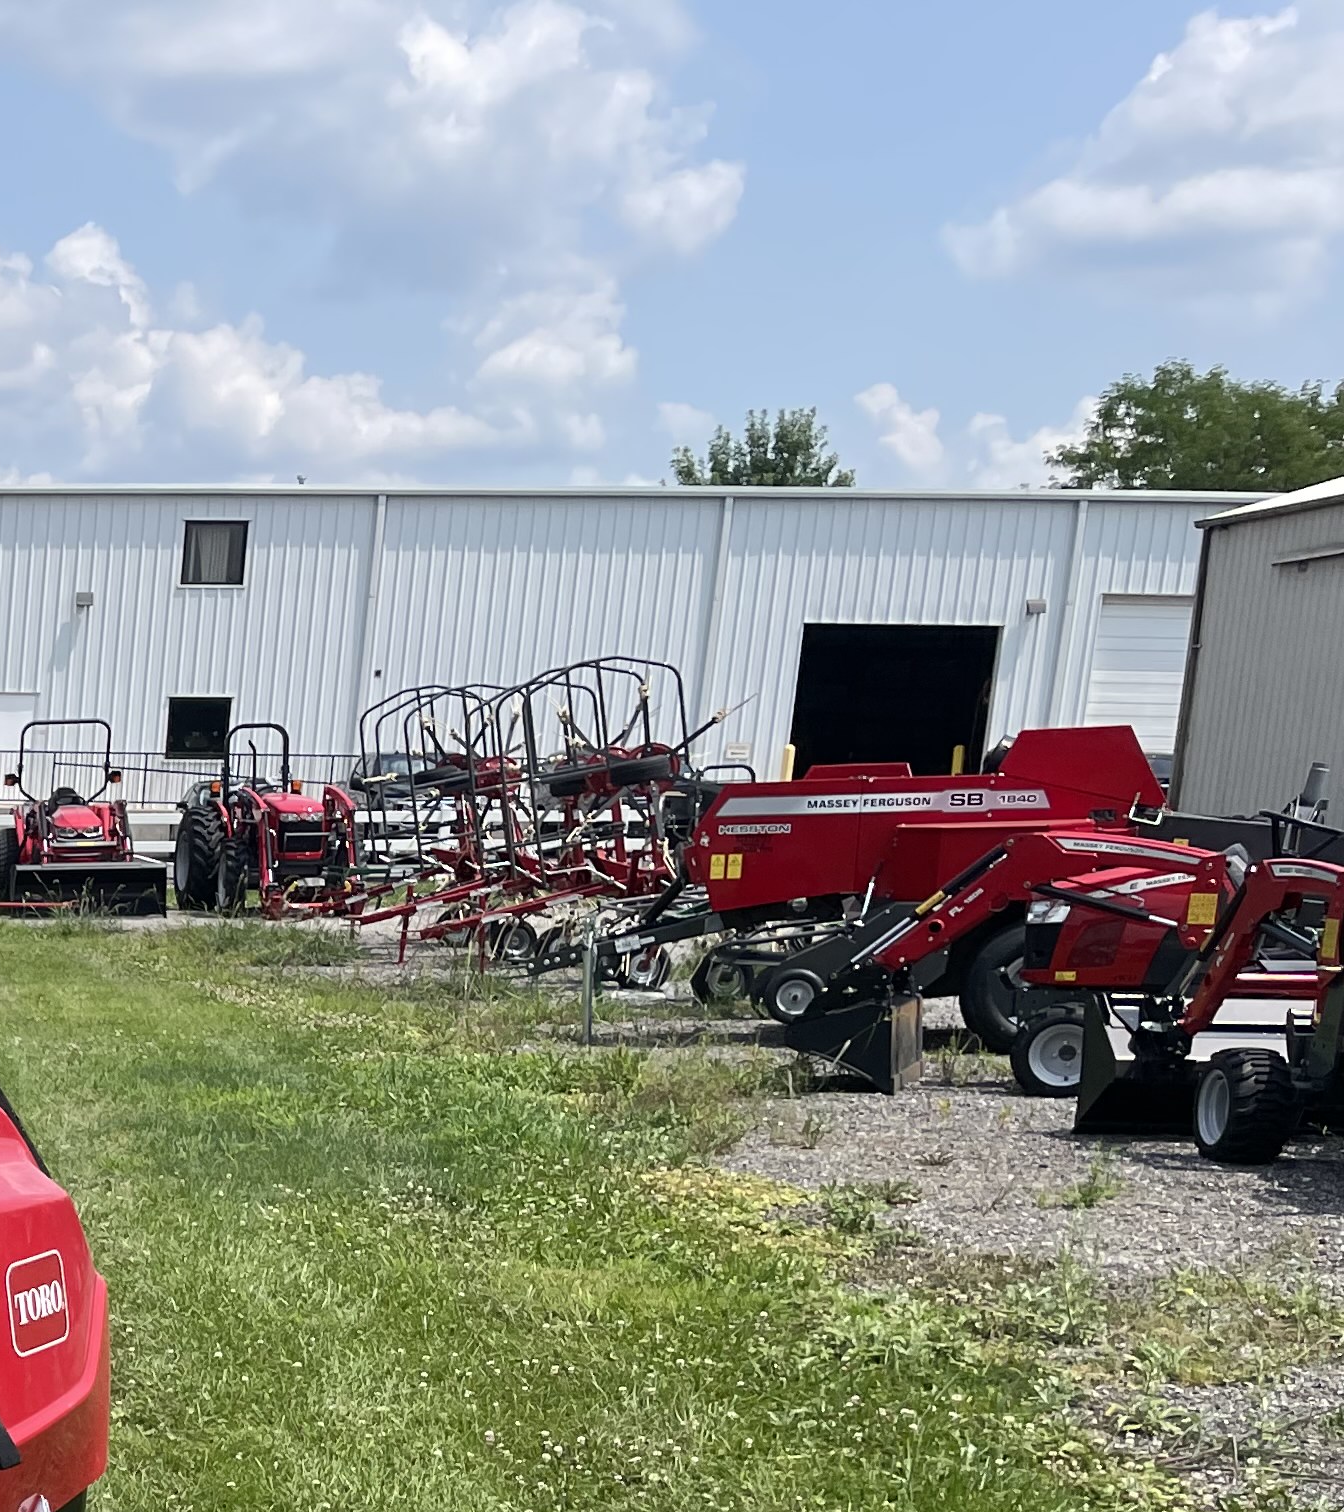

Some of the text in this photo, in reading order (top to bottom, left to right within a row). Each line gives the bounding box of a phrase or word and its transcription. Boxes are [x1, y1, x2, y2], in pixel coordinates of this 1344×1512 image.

[807, 793, 1037, 809] MASSEY FERGUSON SB 1840
[719, 824, 791, 834] HESSTON
[14, 1280, 63, 1325] TORO
